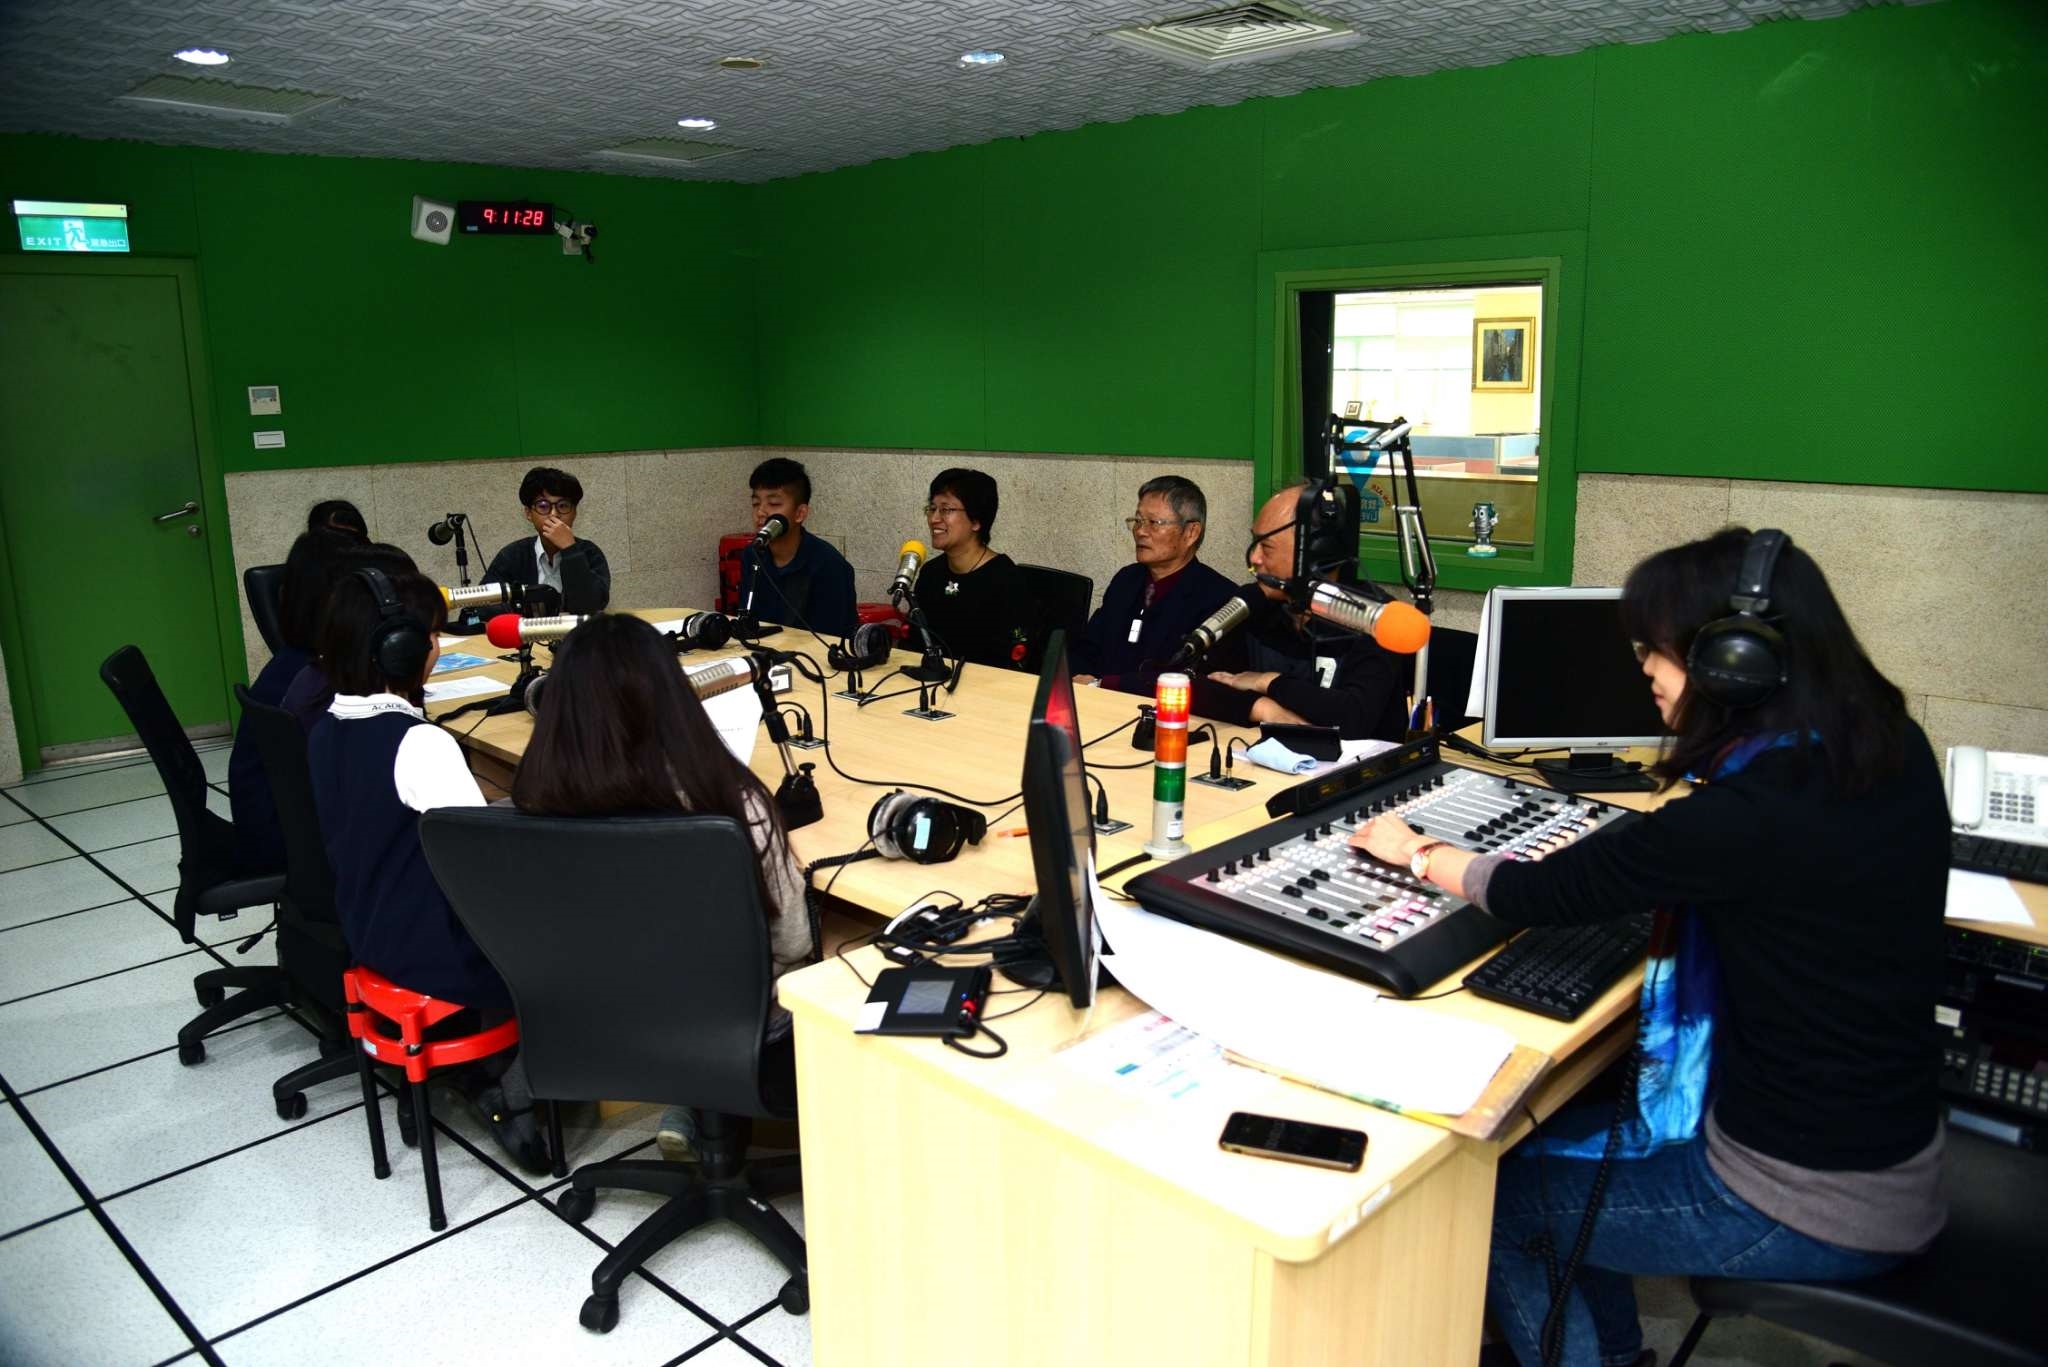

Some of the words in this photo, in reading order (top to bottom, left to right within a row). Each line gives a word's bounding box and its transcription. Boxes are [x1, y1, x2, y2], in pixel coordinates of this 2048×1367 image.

[483, 208, 544, 226] 9:11:28
[26, 237, 62, 246] EXIT
[1315, 656, 1337, 689] 7
